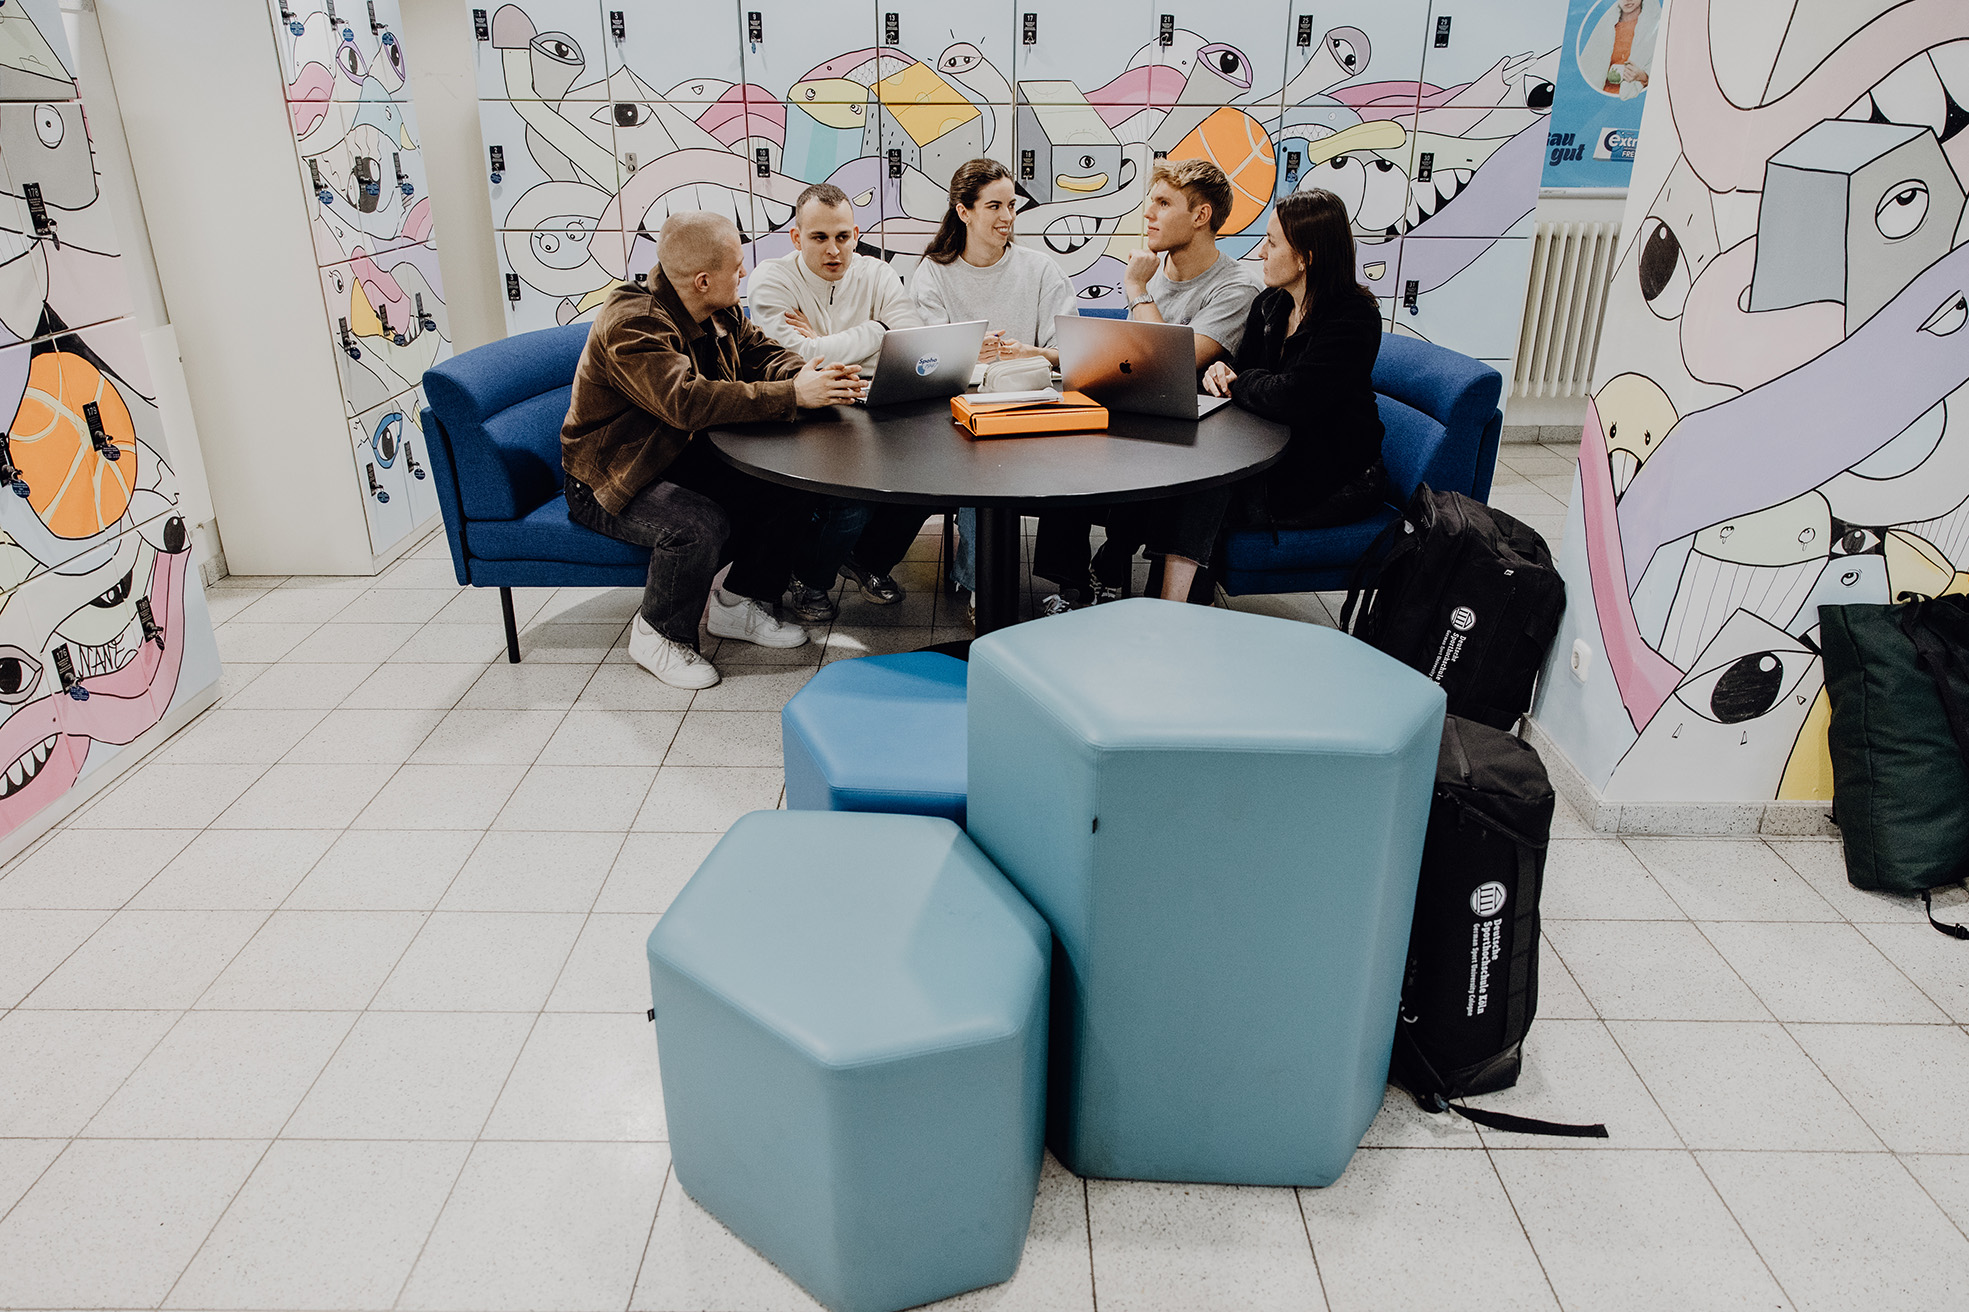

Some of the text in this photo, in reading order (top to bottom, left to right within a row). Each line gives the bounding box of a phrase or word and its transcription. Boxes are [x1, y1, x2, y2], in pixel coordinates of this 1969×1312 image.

[1547, 132, 1576, 146] au
[1608, 134, 1638, 147] extr
[1549, 144, 1586, 167] gut
[1622, 150, 1635, 158] FRE
[27, 188, 39, 197] 178
[87, 406, 98, 416] 179
[56, 648, 68, 660] 176
[1436, 632, 1460, 680] Sporthochschule
[1451, 635, 1467, 662] Deutsche
[1491, 918, 1502, 960] Deutsche
[1466, 923, 1480, 1017] German Sport University Cologne
[1477, 921, 1493, 1015] Sporthochschule Köln
